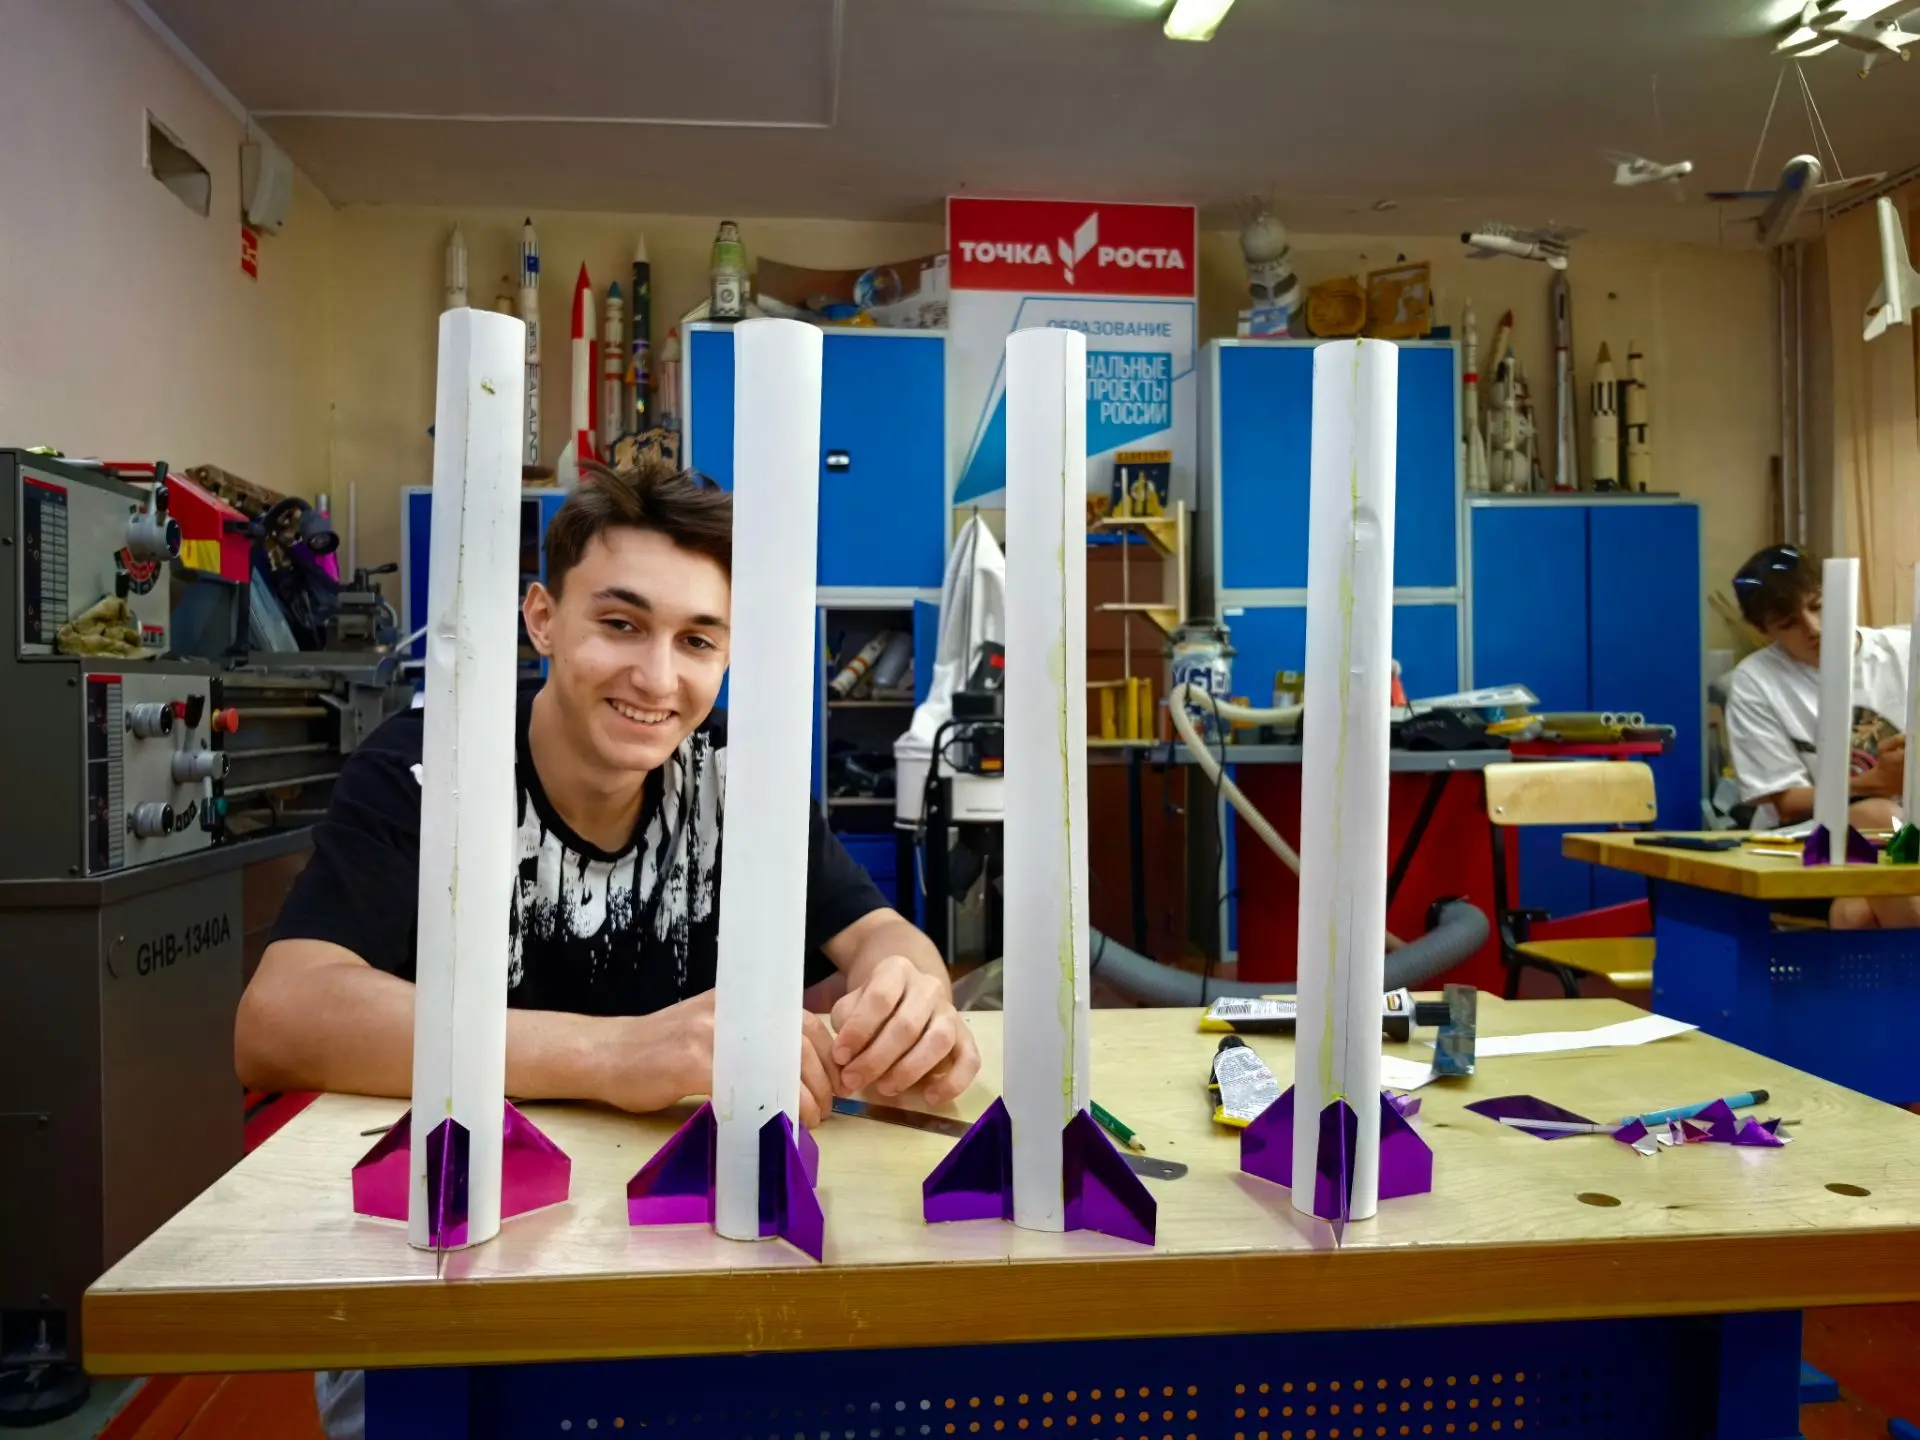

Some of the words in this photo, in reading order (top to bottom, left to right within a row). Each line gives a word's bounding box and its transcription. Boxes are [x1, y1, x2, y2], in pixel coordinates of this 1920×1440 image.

[959, 241, 1053, 265] ТОЧКА
[1097, 246, 1184, 270] РОСТА
[1087, 378, 1168, 402] ПРОЕКТЫ
[1100, 402, 1168, 425] РОССИИ
[136, 912, 231, 977] GHB-1340A
